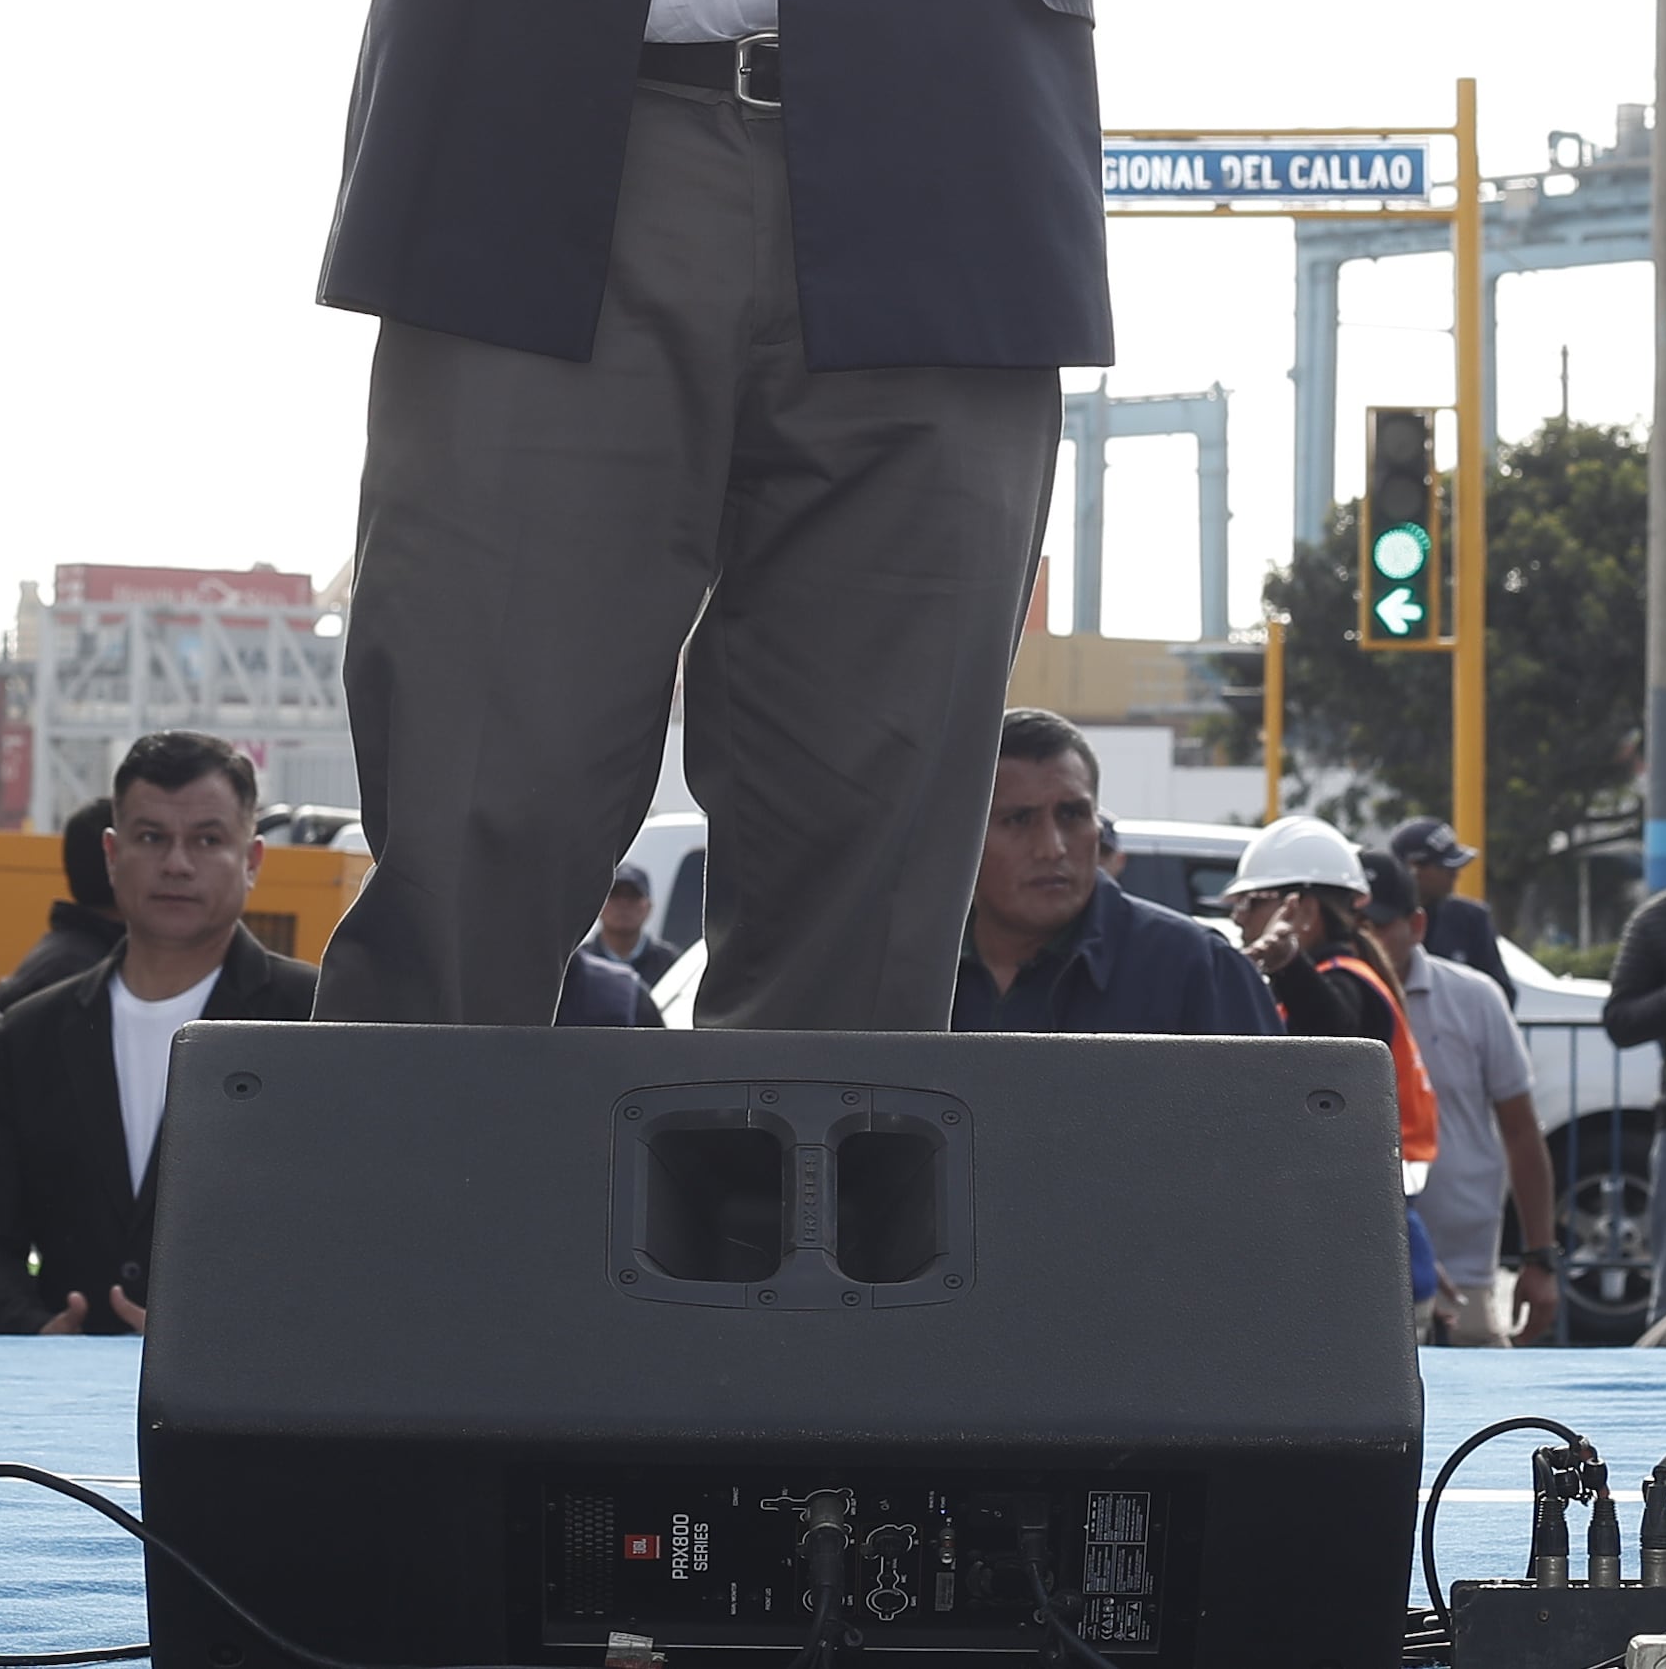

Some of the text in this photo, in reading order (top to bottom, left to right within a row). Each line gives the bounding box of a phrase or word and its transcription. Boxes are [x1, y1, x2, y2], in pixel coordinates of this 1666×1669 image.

[1221, 155, 1281, 190] DEL
[1288, 154, 1413, 190] CALLAO
[632, 1537, 647, 1554] JBL
[672, 1513, 689, 1580] PRX800
[693, 1522, 709, 1572] SERIES
